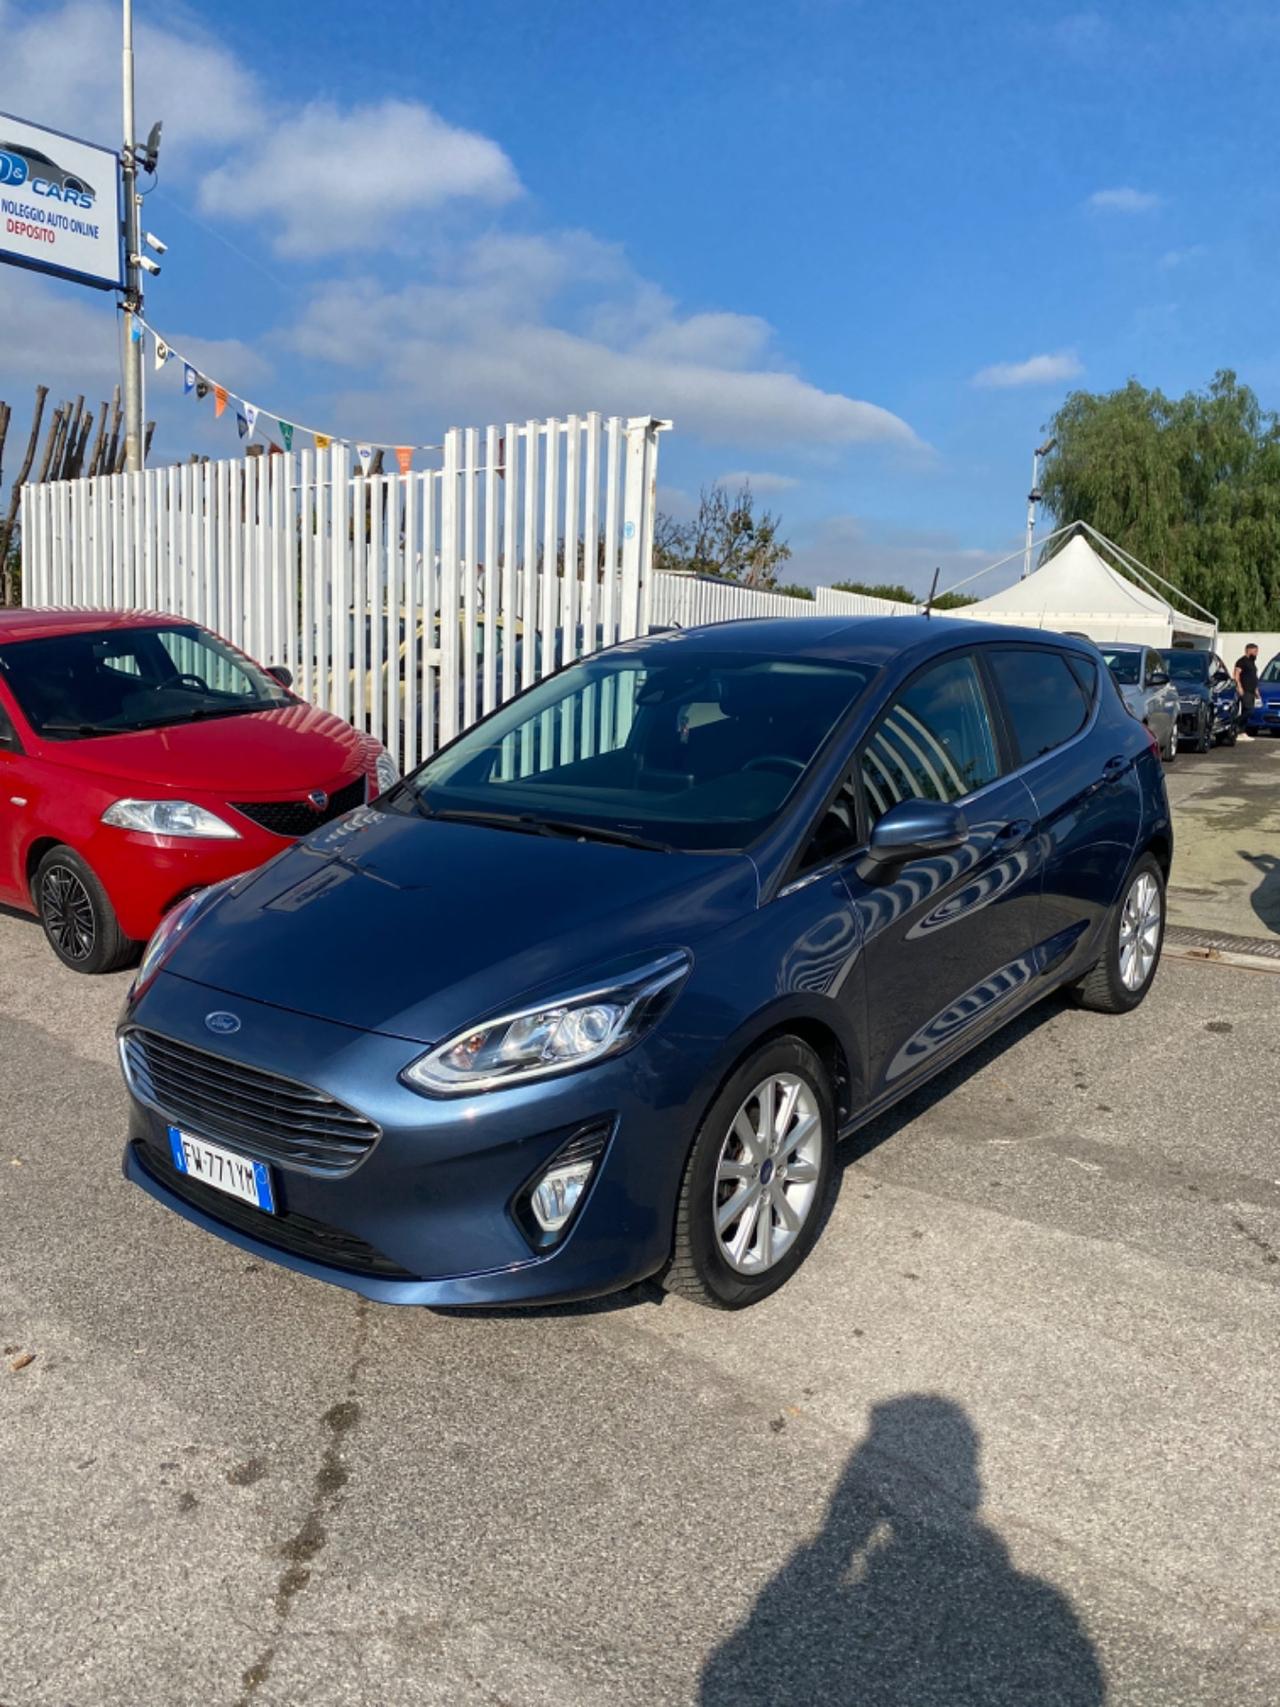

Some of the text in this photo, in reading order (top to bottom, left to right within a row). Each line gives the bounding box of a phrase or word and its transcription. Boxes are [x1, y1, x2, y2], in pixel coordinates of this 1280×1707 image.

[32, 178, 93, 208] CARS
[1, 199, 99, 239] NOLEGGIO AUTO ONLINE
[7, 218, 55, 243] DEPOSITO
